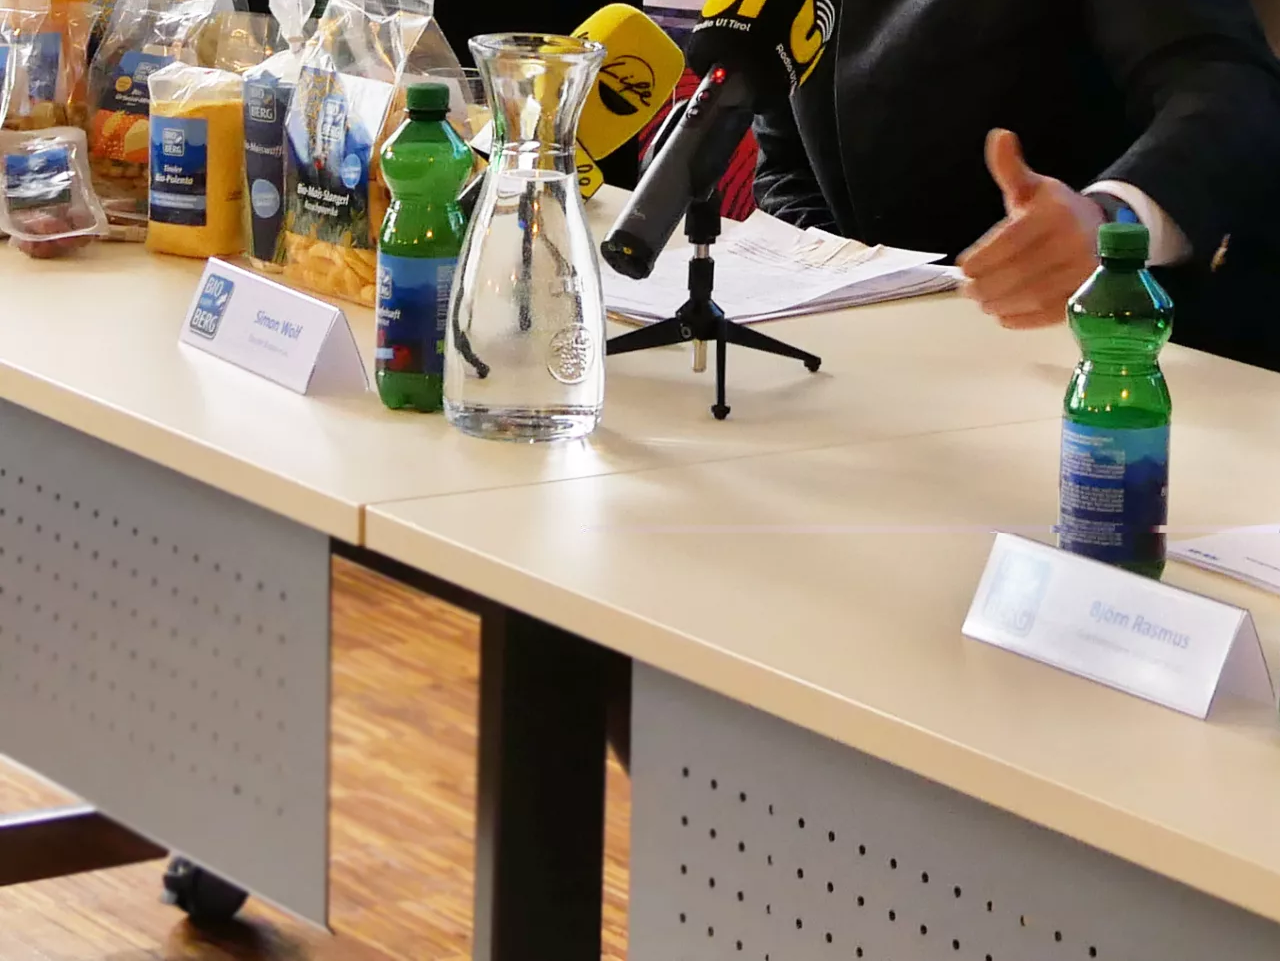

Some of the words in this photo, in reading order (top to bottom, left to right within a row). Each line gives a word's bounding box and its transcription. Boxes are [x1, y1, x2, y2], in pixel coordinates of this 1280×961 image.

[729, 19, 752, 32] Tirol
[775, 42, 793, 73] Radio
[250, 105, 274, 120] BERG
[204, 277, 225, 298] BIO
[191, 307, 219, 333] BERG
[253, 310, 280, 332] Simon
[280, 319, 304, 340] Wolf
[1089, 600, 1130, 629] Björn
[1132, 613, 1192, 650] Rasmus
